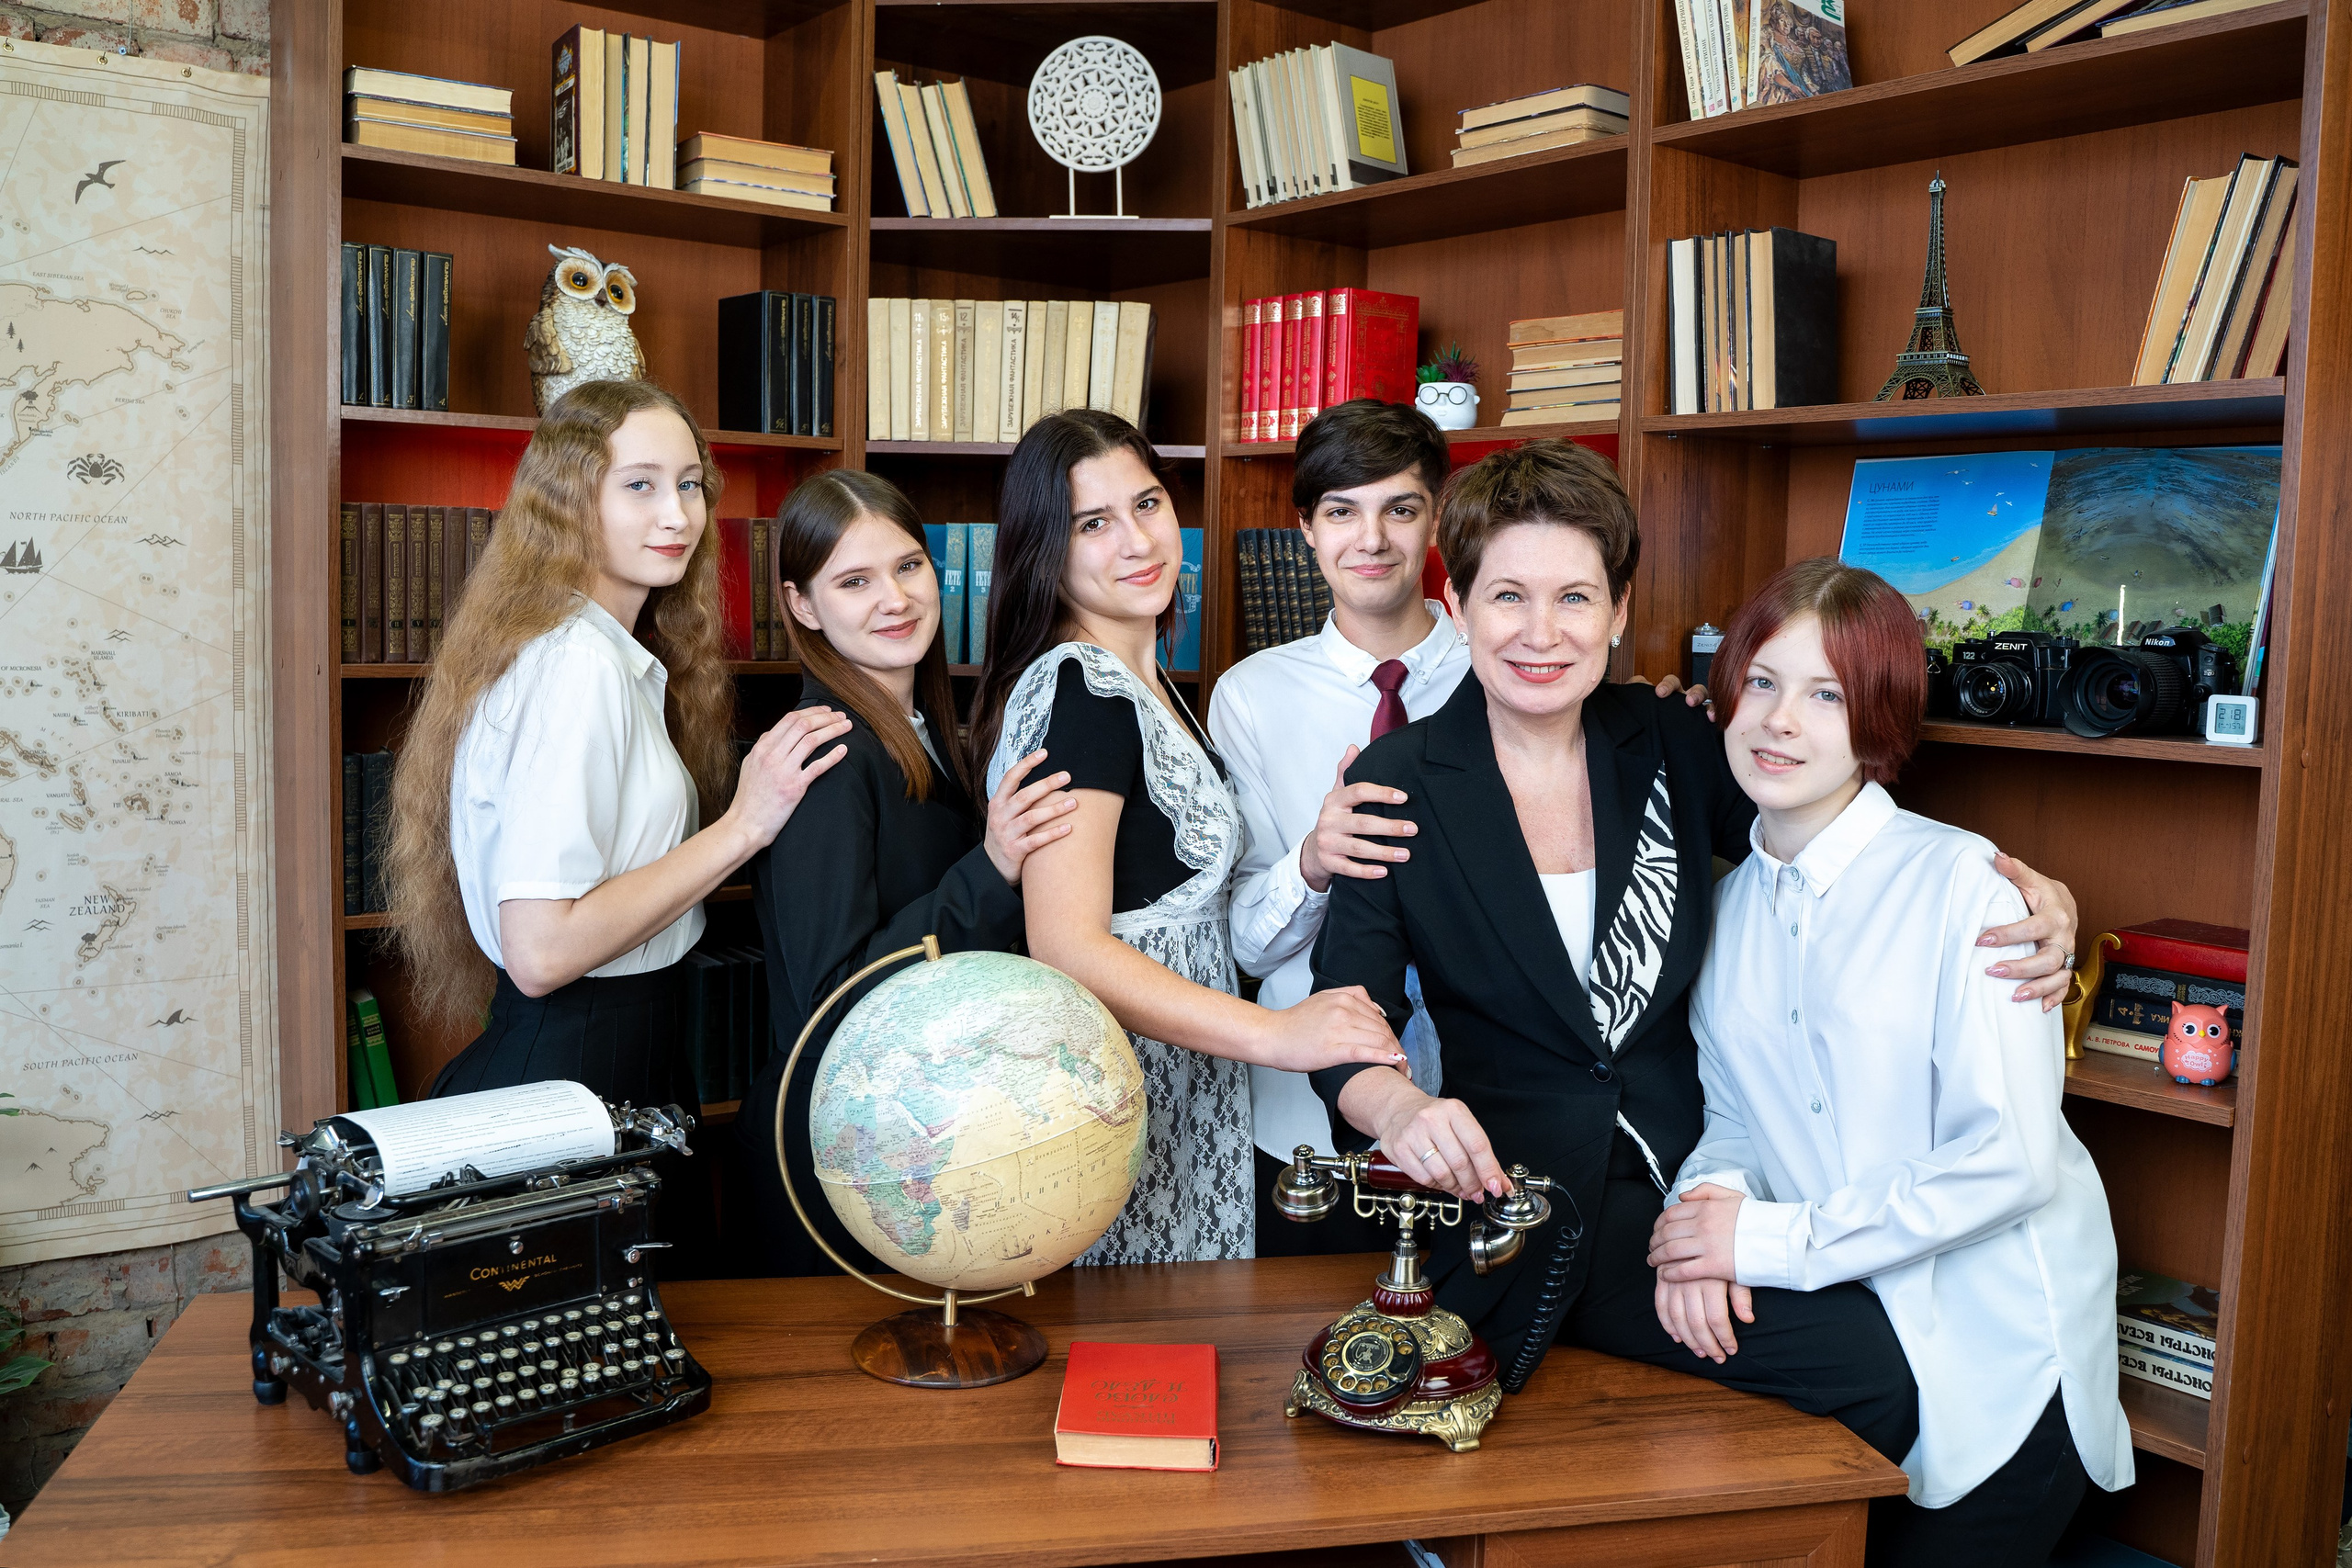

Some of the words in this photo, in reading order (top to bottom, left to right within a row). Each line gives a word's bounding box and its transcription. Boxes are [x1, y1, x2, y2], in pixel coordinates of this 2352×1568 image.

[1722, 3, 1731, 31] ПРУТКОВА
[1710, 28, 1718, 57] БОЛЬШИЕ
[1685, 51, 1691, 60] ИЗ
[1702, 38, 1710, 67] ПУРИТАНЕ
[1727, 56, 1736, 91] СОЧИНЕНИЯ
[960, 312, 968, 321] 12
[1007, 383, 1015, 428] ЗАРУБЕЖНАЯ
[1869, 481, 1915, 494] ЦУНАМИ
[9, 511, 47, 522] NORTH
[50, 513, 91, 524] PACIFIC
[93, 514, 129, 525] OCEAN
[944, 570, 962, 586] ГЕТЕ
[1994, 642, 2028, 651] ZENIT
[2144, 637, 2170, 647] Nikon
[1962, 651, 1975, 660] 122
[84, 894, 109, 905] NEW
[69, 903, 125, 917] ZEALAND
[2118, 1006, 2129, 1016] 4
[2151, 1012, 2170, 1024] ИКА
[2101, 1037, 2131, 1048] ПЕТРОВА
[2133, 1043, 2160, 1054] САМОУ
[22, 1060, 58, 1072] SOUTH
[62, 1055, 102, 1067] PACIFIC
[104, 1052, 139, 1063] OCEAN
[2185, 1054, 2209, 1063] Happy
[994, 1158, 1107, 1209] ИНДИЙСКИЙ
[1028, 1209, 1095, 1241] ОКЕАН
[2117, 1323, 2155, 1344] ВСЕЛ
[2160, 1335, 2215, 1361] ОНСТРЫ
[1091, 1378, 1161, 1392] ДЕЛО
[2152, 1364, 2212, 1393] ОНСТРЫ
[1094, 1392, 1179, 1403] СЛОВО
